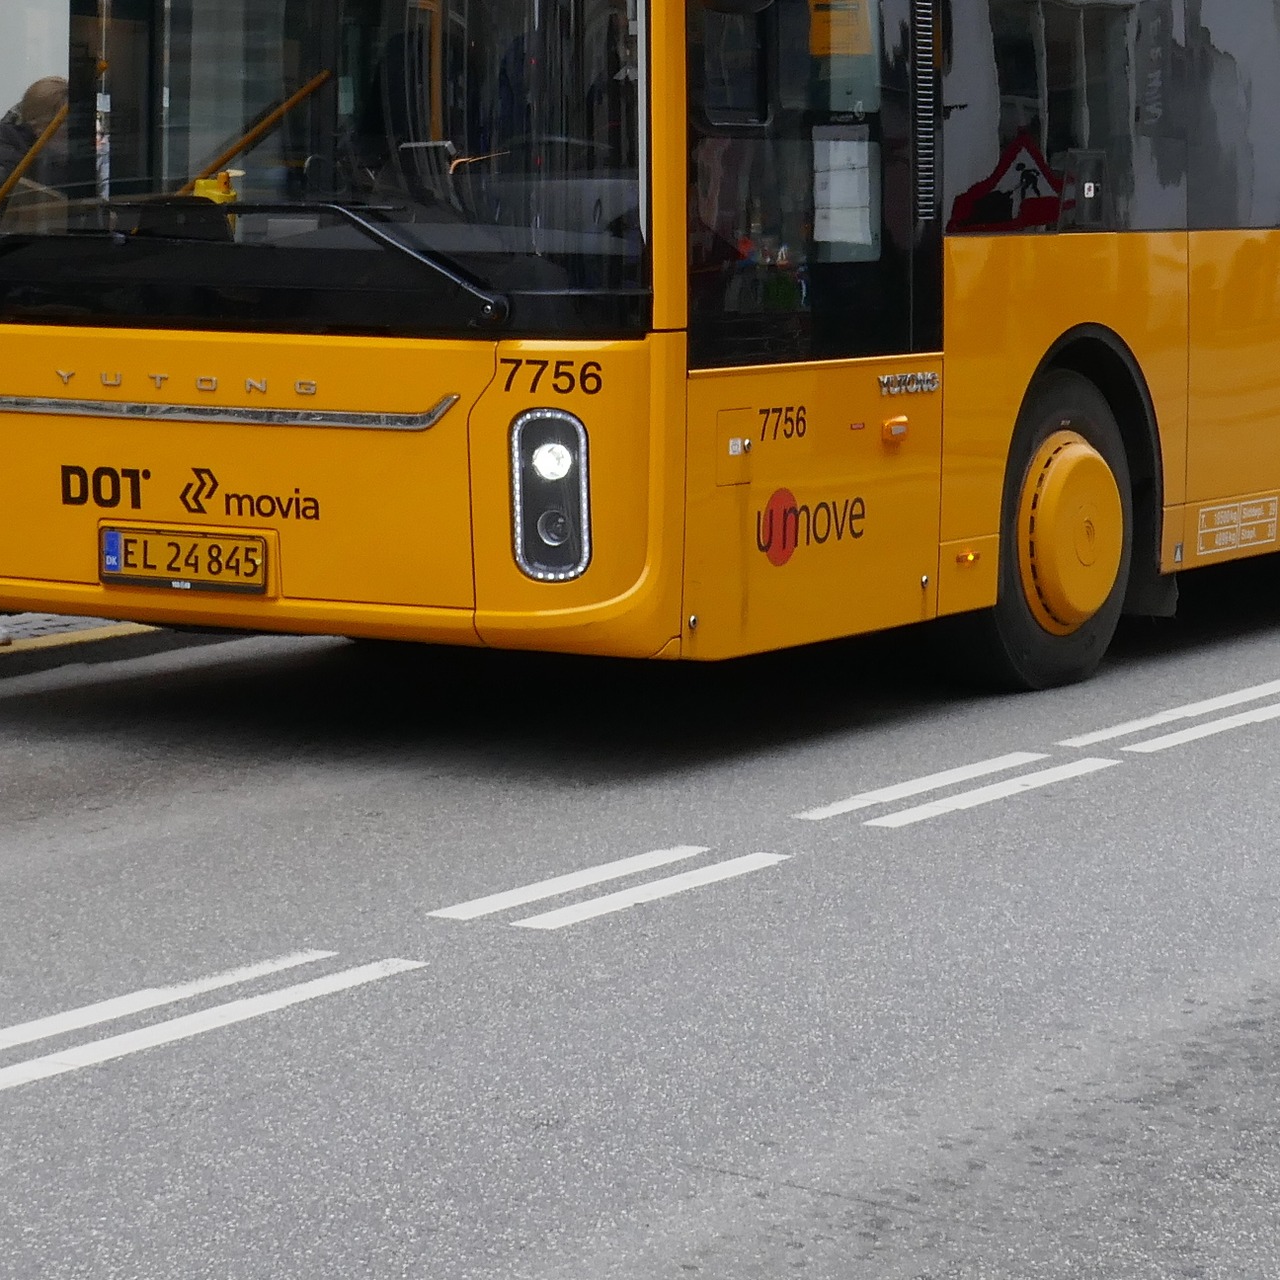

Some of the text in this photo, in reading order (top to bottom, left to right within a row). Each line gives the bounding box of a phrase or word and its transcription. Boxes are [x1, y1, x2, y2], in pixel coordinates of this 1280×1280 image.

[56, 369, 318, 395] YUTONG
[500, 358, 603, 395] 7756
[877, 371, 940, 396] YUTONG
[758, 405, 807, 442] 7756
[61, 465, 150, 509] DOT
[224, 488, 320, 520] movia
[106, 554, 118, 566] DK
[123, 538, 259, 578] EL 24 845
